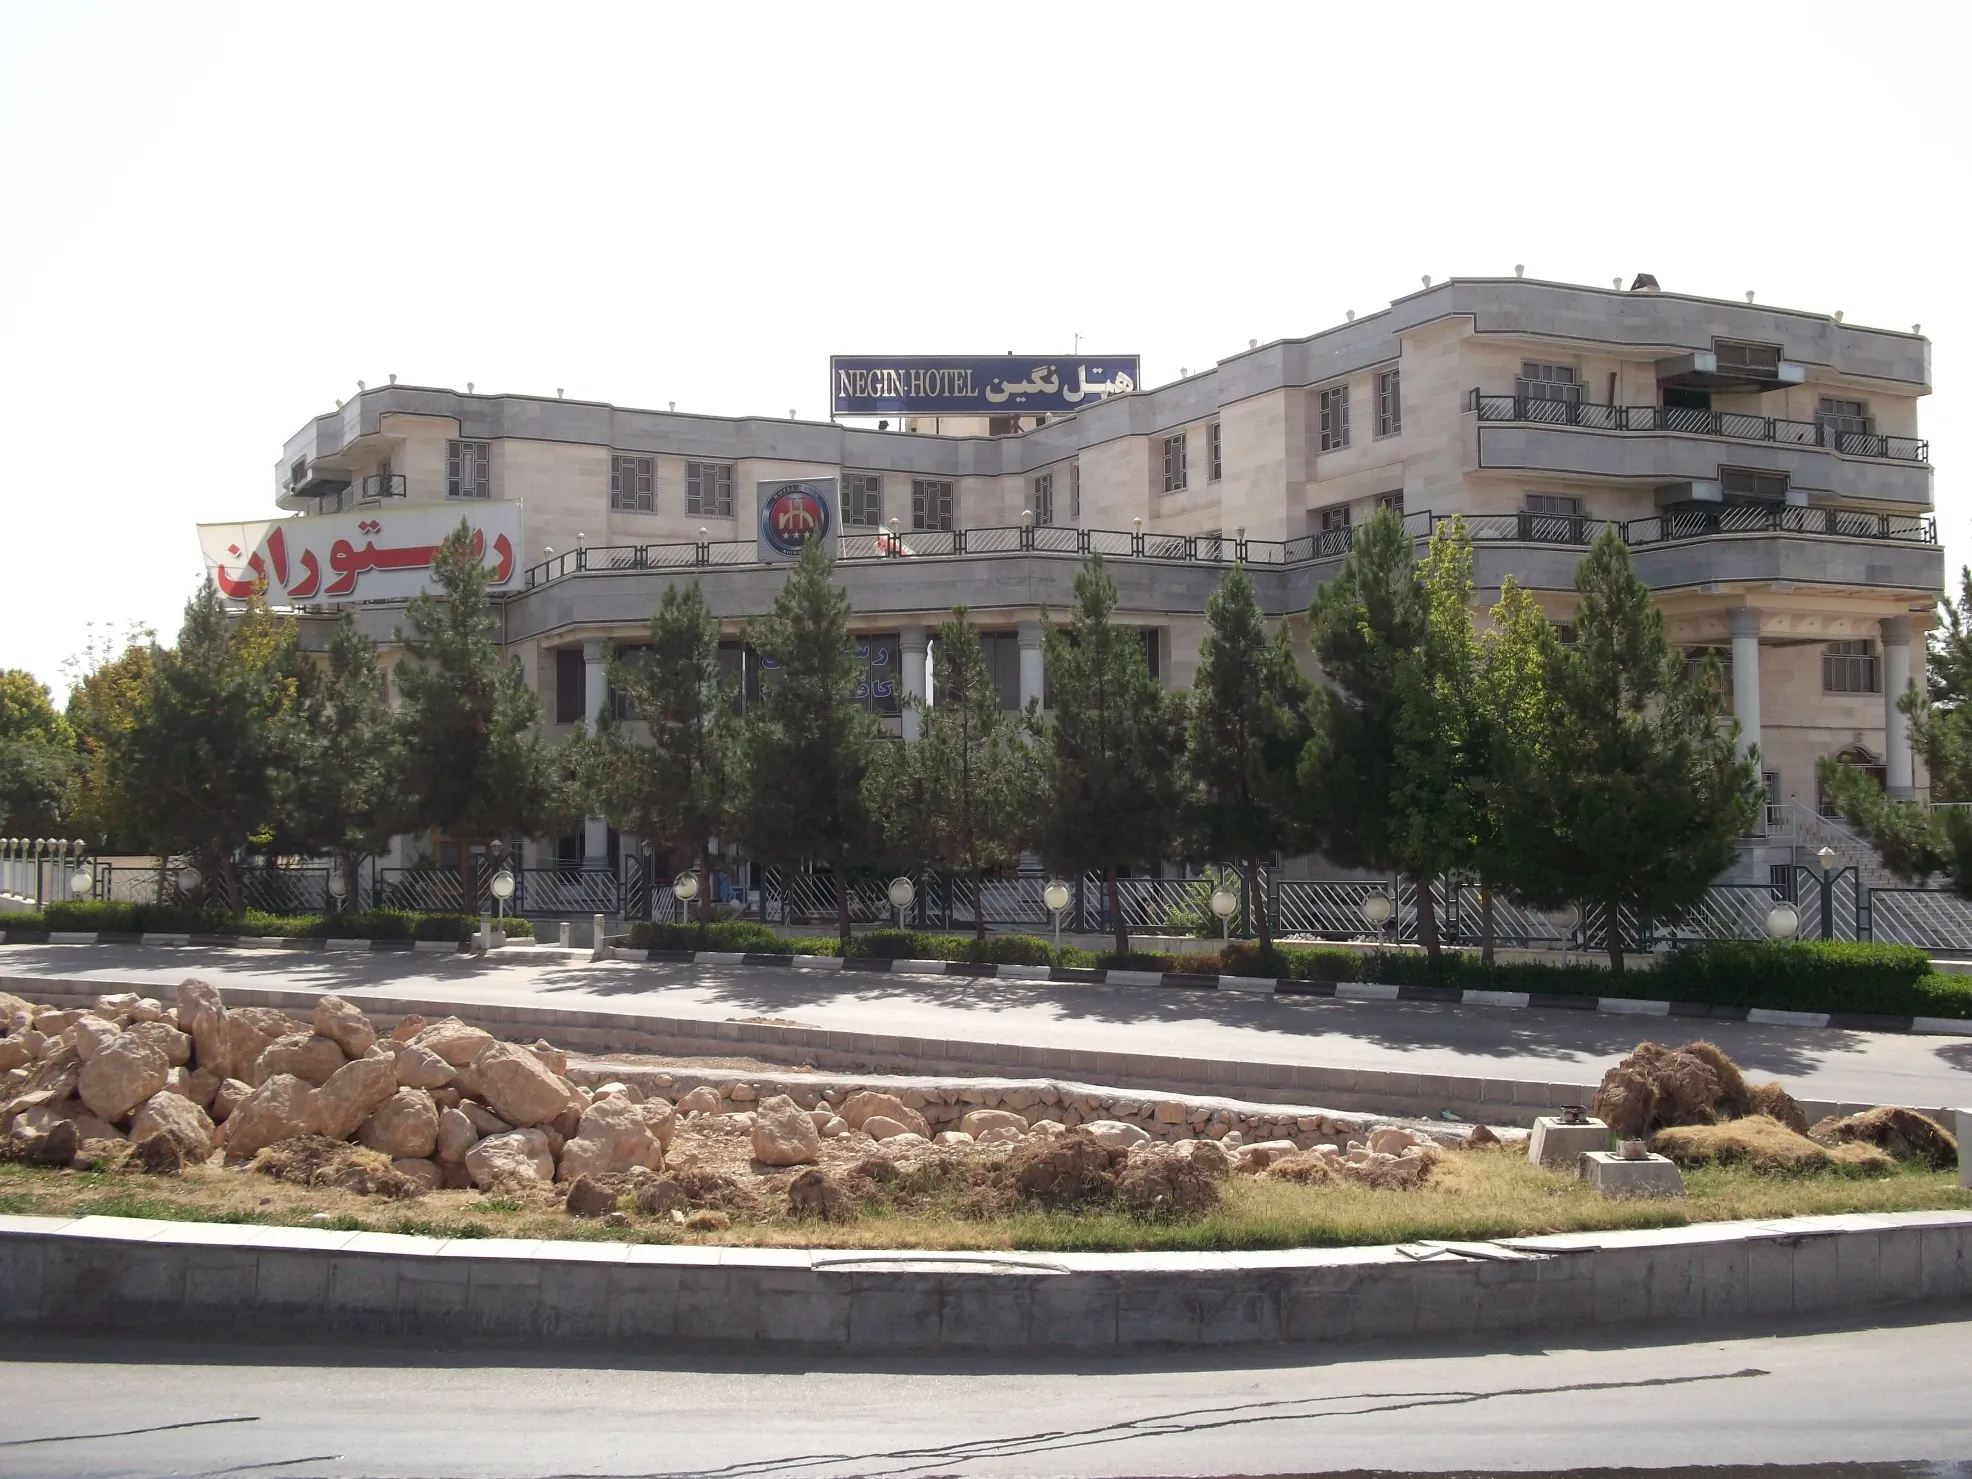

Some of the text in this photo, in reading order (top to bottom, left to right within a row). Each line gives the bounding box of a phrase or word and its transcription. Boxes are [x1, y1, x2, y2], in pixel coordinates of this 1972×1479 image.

[838, 369, 978, 398] NEGIN HOTEL
[985, 364, 1134, 403] هتل نگین
[774, 486, 795, 499] HOTEL
